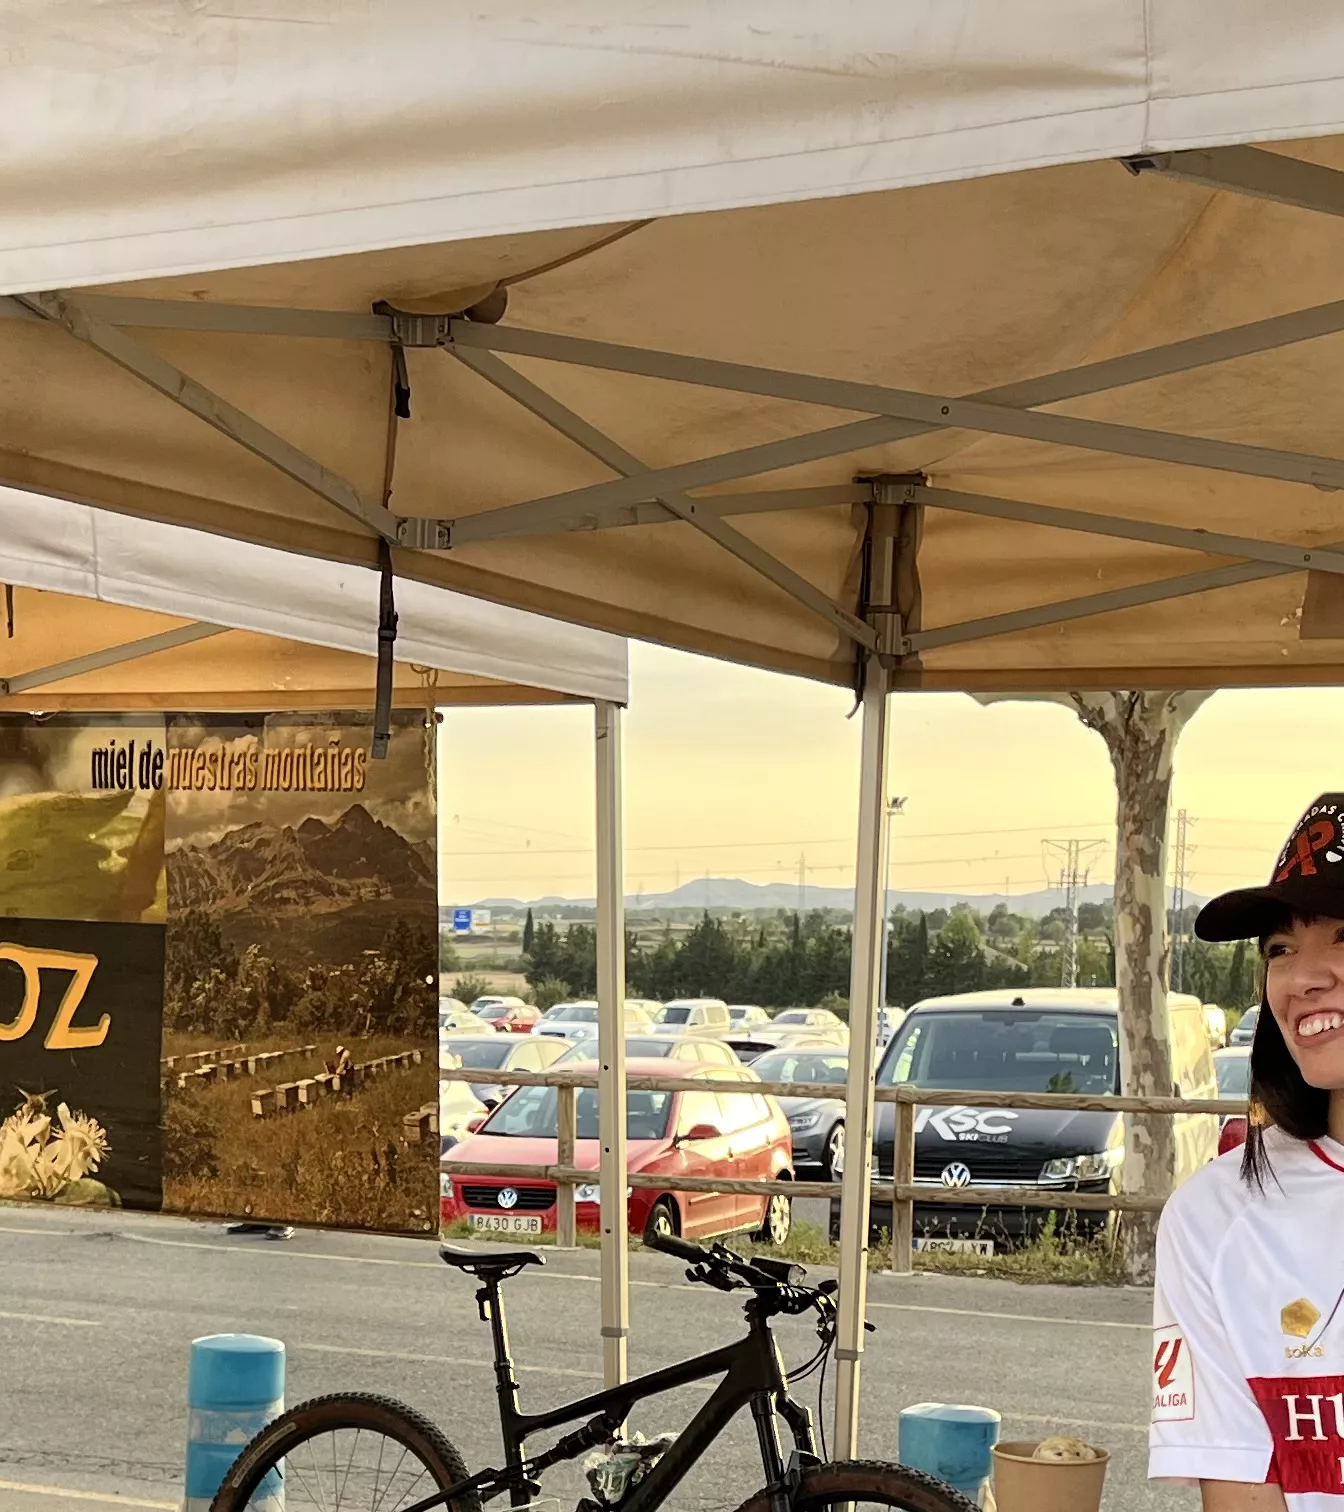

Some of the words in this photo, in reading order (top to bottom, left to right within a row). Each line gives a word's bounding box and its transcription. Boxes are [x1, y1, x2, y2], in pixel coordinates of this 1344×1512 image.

[91, 739, 135, 790] miel
[139, 739, 164, 790] de
[167, 742, 258, 791] nuestras
[262, 738, 367, 792] montañas
[915, 1105, 1019, 1141] KSC
[477, 1217, 508, 1231] 8430
[515, 1219, 538, 1232] GJB
